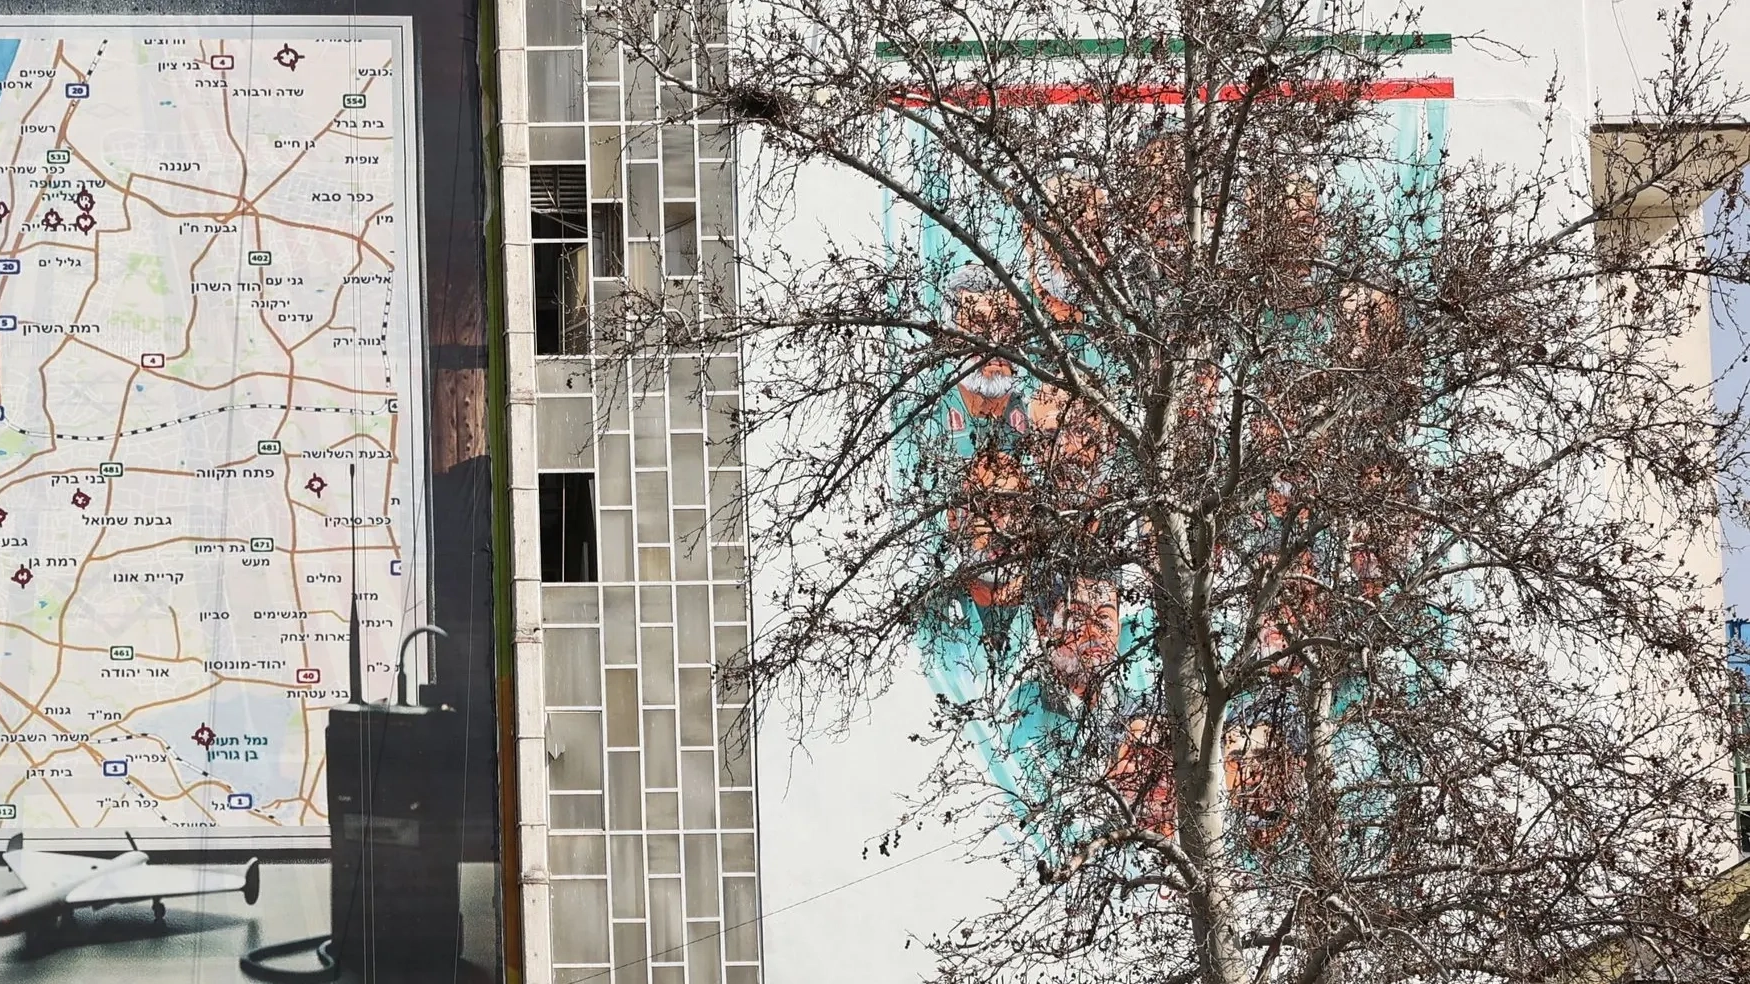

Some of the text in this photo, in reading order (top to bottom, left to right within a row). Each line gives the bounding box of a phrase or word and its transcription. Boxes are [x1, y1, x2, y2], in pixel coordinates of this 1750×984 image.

[158, 62, 200, 72] בני ציון
[358, 68, 392, 76] כובש
[19, 69, 56, 79] שפיים
[195, 79, 228, 88] בצרה
[278, 88, 304, 97] שדה
[363, 119, 384, 129] בית
[20, 124, 56, 136] רשפון
[274, 140, 316, 150] גן חיים
[42, 165, 65, 175] כפר
[159, 162, 201, 172] רעננה
[311, 192, 374, 202] כפר סבא
[204, 225, 237, 233] גבעת
[38, 257, 82, 268] גליל ים
[266, 277, 304, 286] גני עם
[343, 274, 392, 285] אלישמע
[191, 283, 261, 295] הוד השרון
[278, 313, 314, 322] עדנים
[23, 324, 100, 336] רמת השרון
[333, 338, 353, 348] ירק
[302, 449, 392, 459] גבעת השלושה
[196, 469, 275, 480] פתח תקווה
[51, 475, 106, 487] בני ברק
[81, 514, 172, 526] גבעת שמואל
[367, 516, 391, 525] כפר
[195, 544, 246, 555] גת רימון
[29, 558, 77, 569] רמת גן
[242, 558, 270, 567] מעש
[113, 573, 184, 584] קריית אונו
[306, 573, 342, 584] נחלים
[200, 611, 230, 622] סביון
[253, 610, 308, 620] מגשימים
[362, 619, 393, 628] רינתי
[280, 633, 310, 644] יצחק
[101, 669, 170, 678] אור יהודה
[286, 690, 350, 699] בני עטרות
[44, 706, 71, 715] גנות
[0, 733, 90, 743] משמר השבעה
[244, 734, 268, 746] נמל
[207, 750, 259, 762] בן גוריון
[26, 768, 73, 779] בית דגן
[134, 799, 159, 808] כפר
